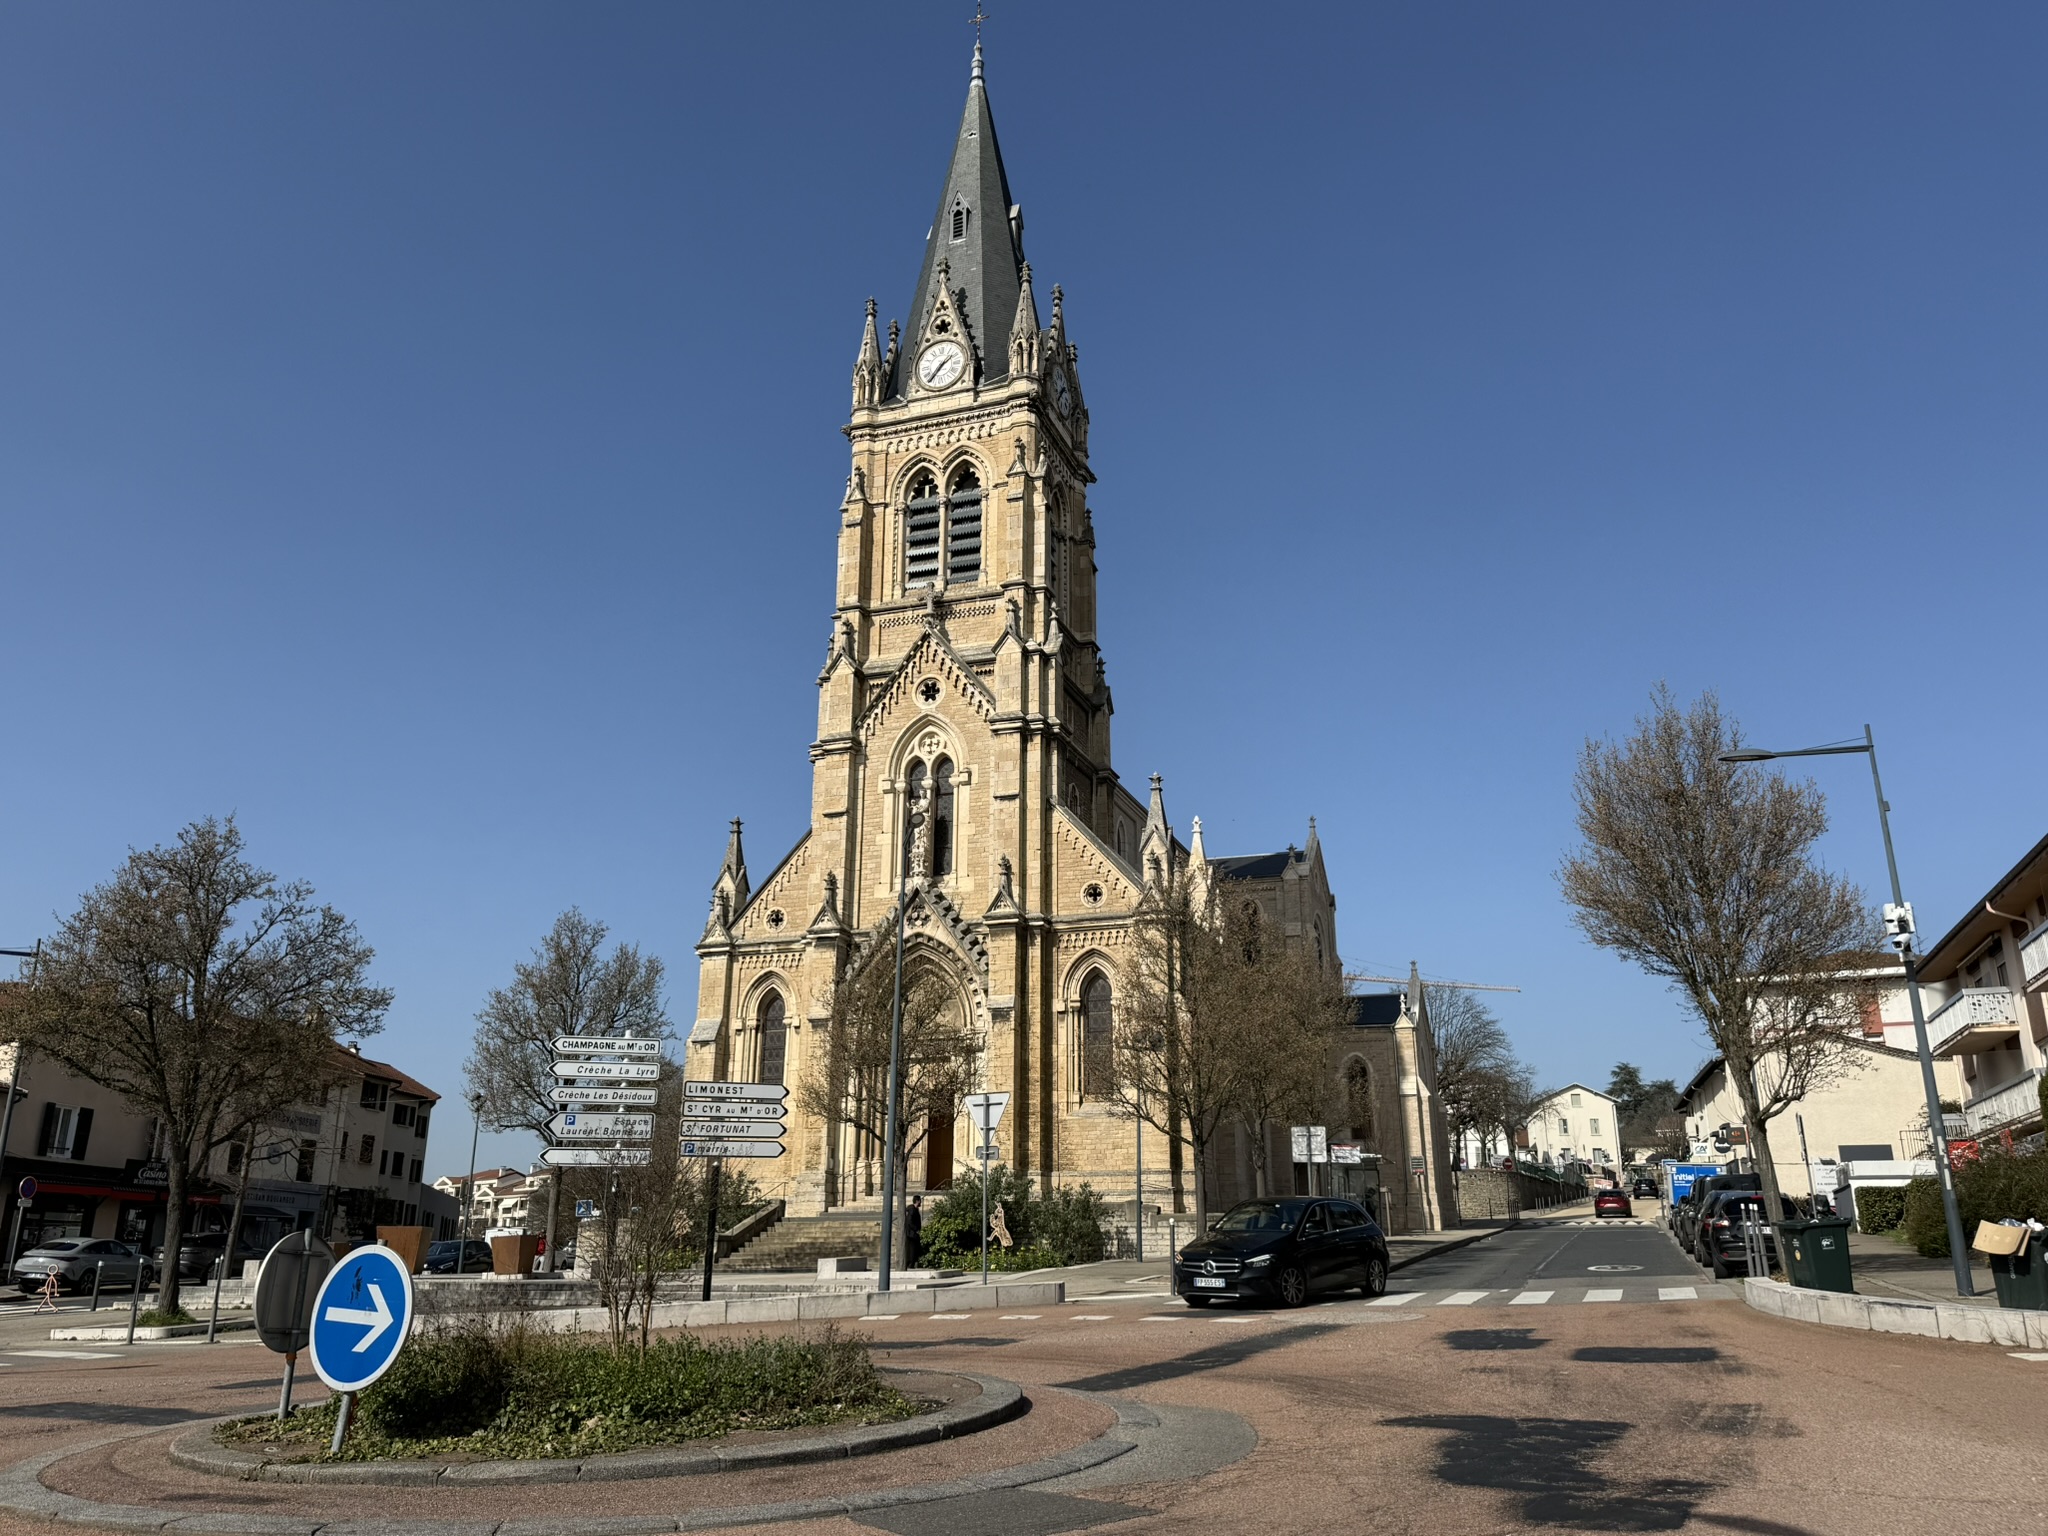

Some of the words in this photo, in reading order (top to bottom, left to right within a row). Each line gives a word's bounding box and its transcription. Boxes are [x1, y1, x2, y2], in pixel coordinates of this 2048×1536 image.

[562, 1040, 616, 1050] CHAMPAGNE
[577, 1065, 612, 1074] Crèche
[618, 1066, 630, 1074] La
[636, 1066, 655, 1076] Lyre
[688, 1085, 744, 1094] LIMONEST
[558, 1090, 590, 1099] Crèche
[593, 1092, 608, 1100] Les
[612, 1092, 653, 1100] Désidoux
[702, 1105, 721, 1113] CYR
[614, 1117, 649, 1126] Espace
[560, 1127, 598, 1136] Laurent
[602, 1128, 650, 1137] Bonnevay
[700, 1124, 751, 1134] FORTUNAT
[697, 1145, 729, 1153] mairie
[138, 1167, 167, 1179] Casino
